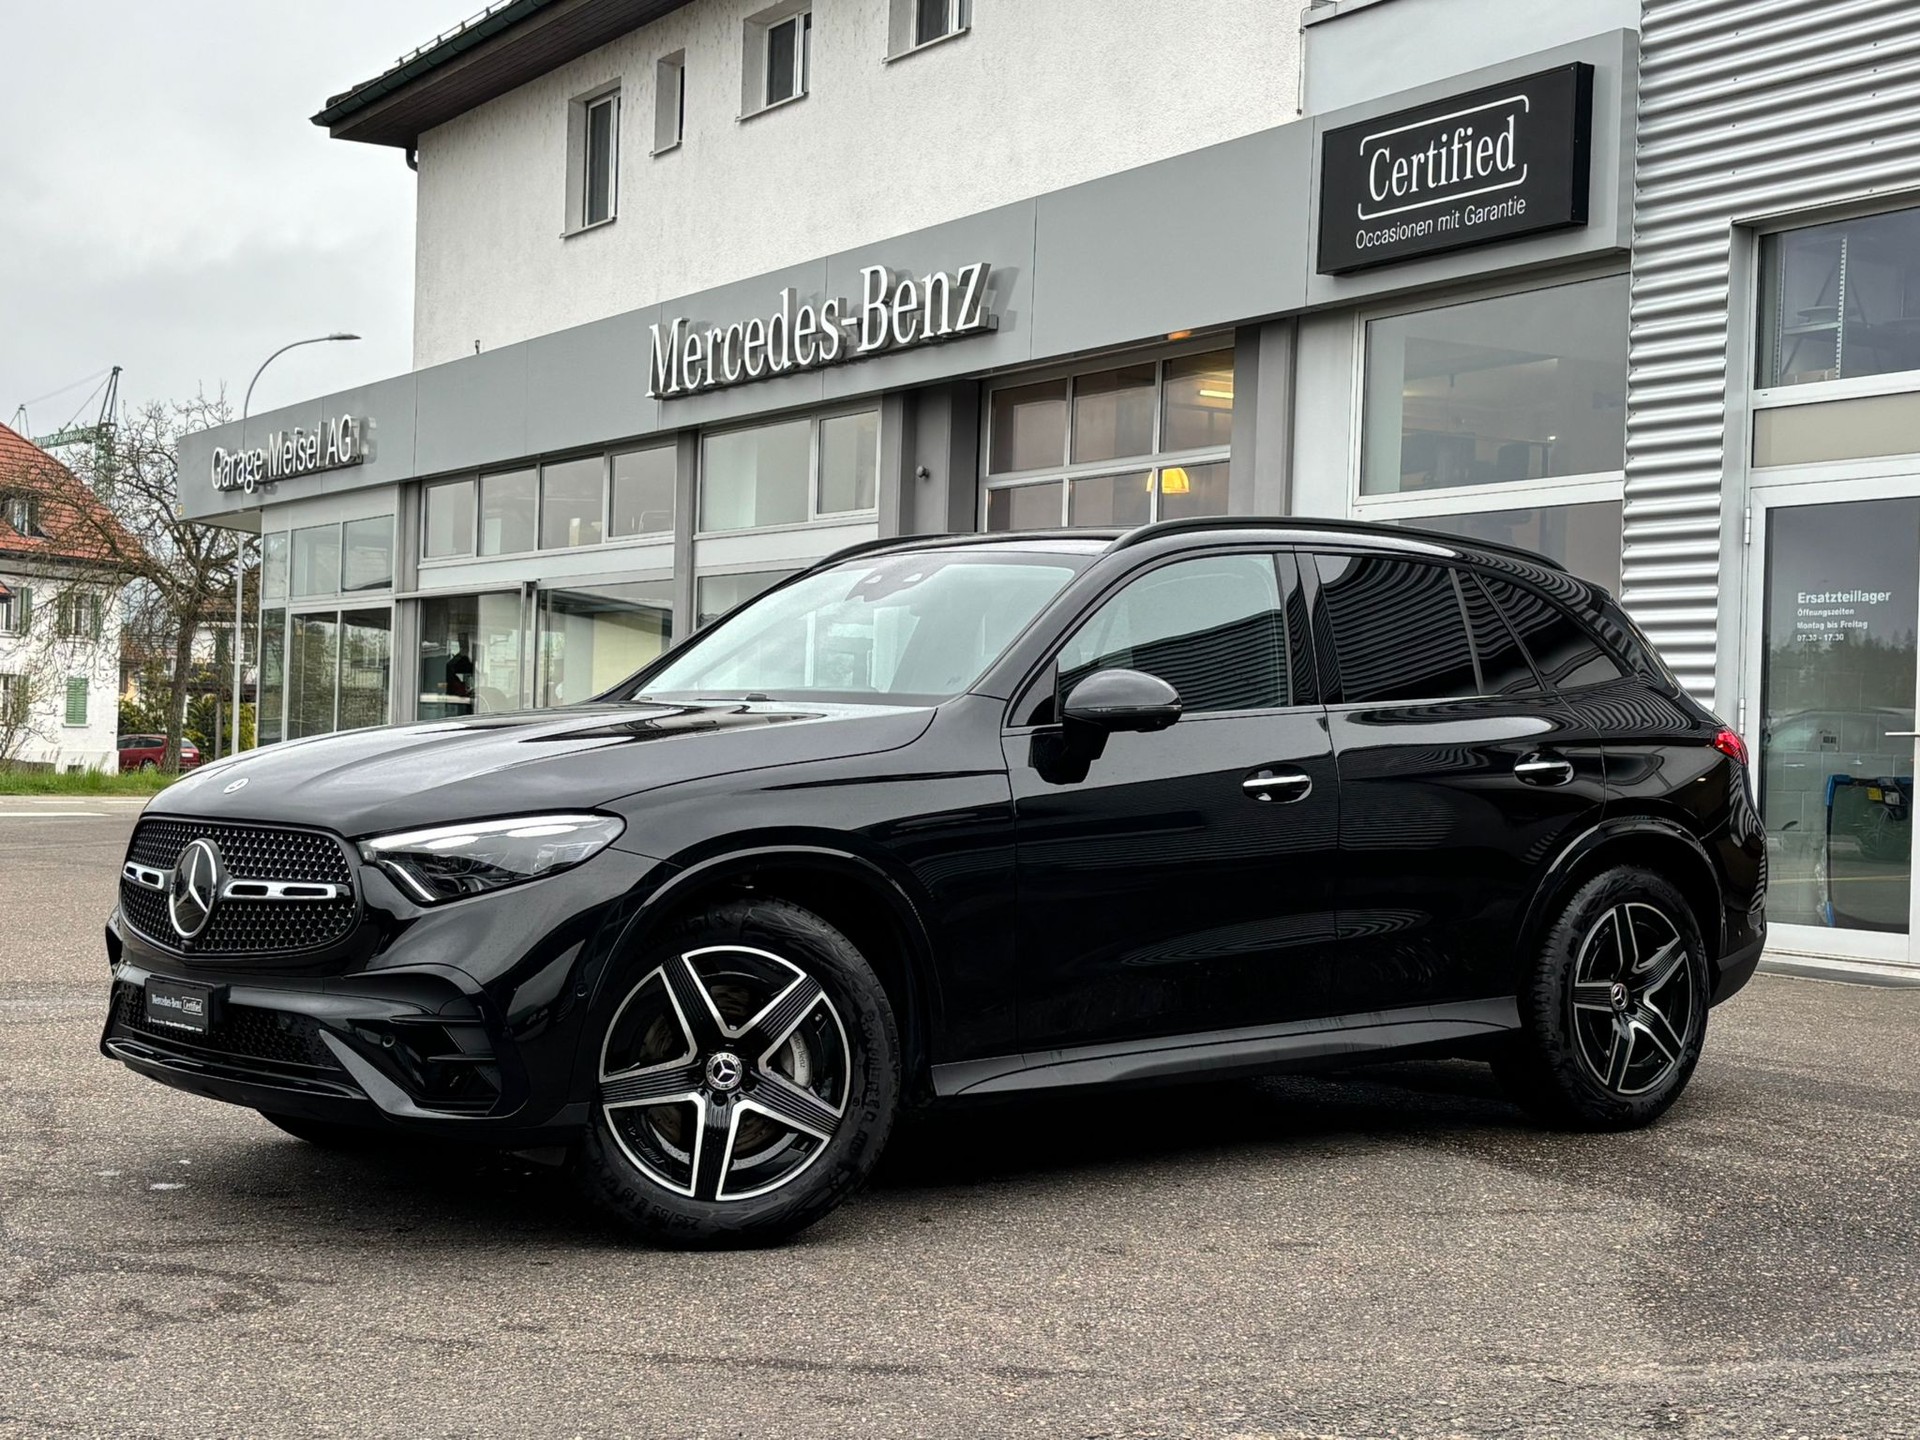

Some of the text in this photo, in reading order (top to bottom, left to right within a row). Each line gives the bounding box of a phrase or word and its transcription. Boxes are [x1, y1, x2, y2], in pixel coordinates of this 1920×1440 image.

[1368, 114, 1516, 202] Certified
[1355, 196, 1526, 249] Occasionen mit Garantie
[645, 262, 989, 397] Mercedes-Benz
[211, 414, 352, 494] Garage Meisel AG
[1797, 590, 1892, 604] Ersatzteillager
[1797, 608, 1855, 617] Öffnungszeiten
[1797, 620, 1868, 630] Montag bis Freitag
